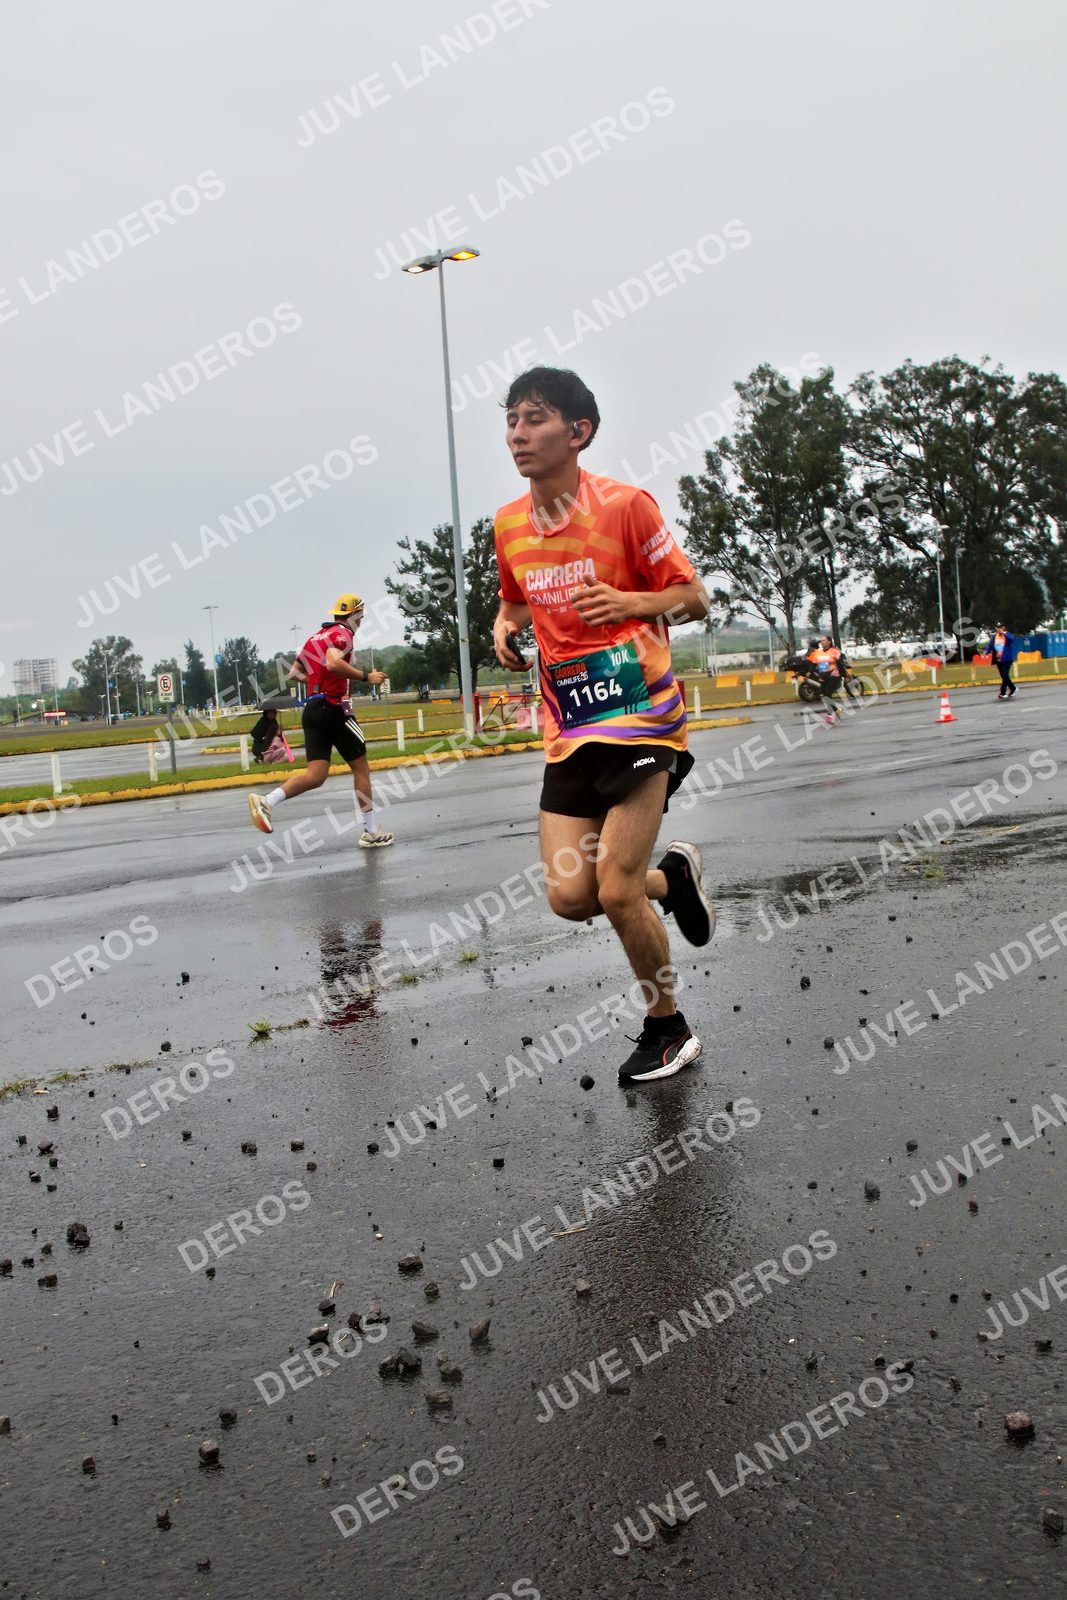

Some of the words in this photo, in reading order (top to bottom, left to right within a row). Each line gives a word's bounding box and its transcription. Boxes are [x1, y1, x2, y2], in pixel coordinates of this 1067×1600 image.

[525, 558, 596, 591] CARRERA
[610, 649, 629, 667] 10K
[554, 662, 587, 680] CARRERA
[569, 679, 623, 707] 1164
[633, 756, 656, 769] HOKA
